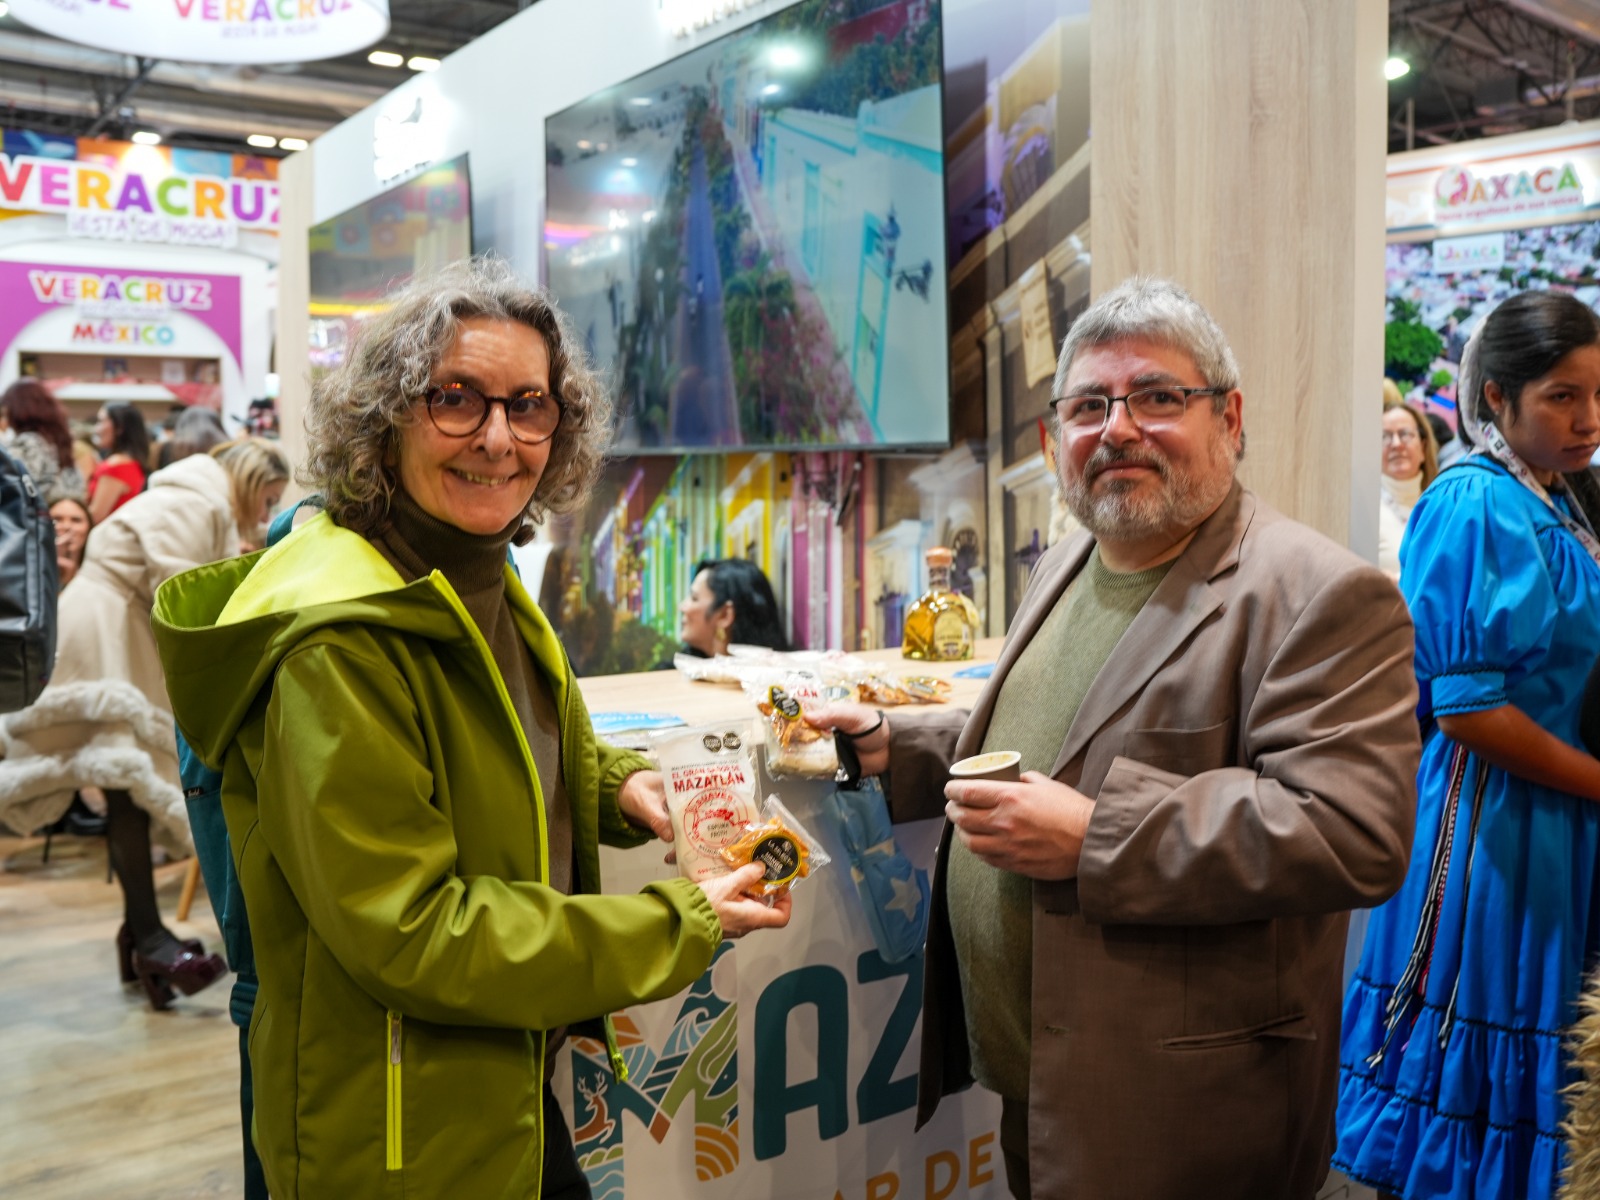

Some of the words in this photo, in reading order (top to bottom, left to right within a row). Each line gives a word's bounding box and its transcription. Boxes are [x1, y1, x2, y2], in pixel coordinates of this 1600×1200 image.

[0, 161, 279, 223] VERACRU
[1435, 165, 1580, 207] OAXACA
[36, 275, 205, 305] VERACRUZ
[673, 771, 745, 793] MAZATLÁN
[925, 1131, 995, 1200] DE
